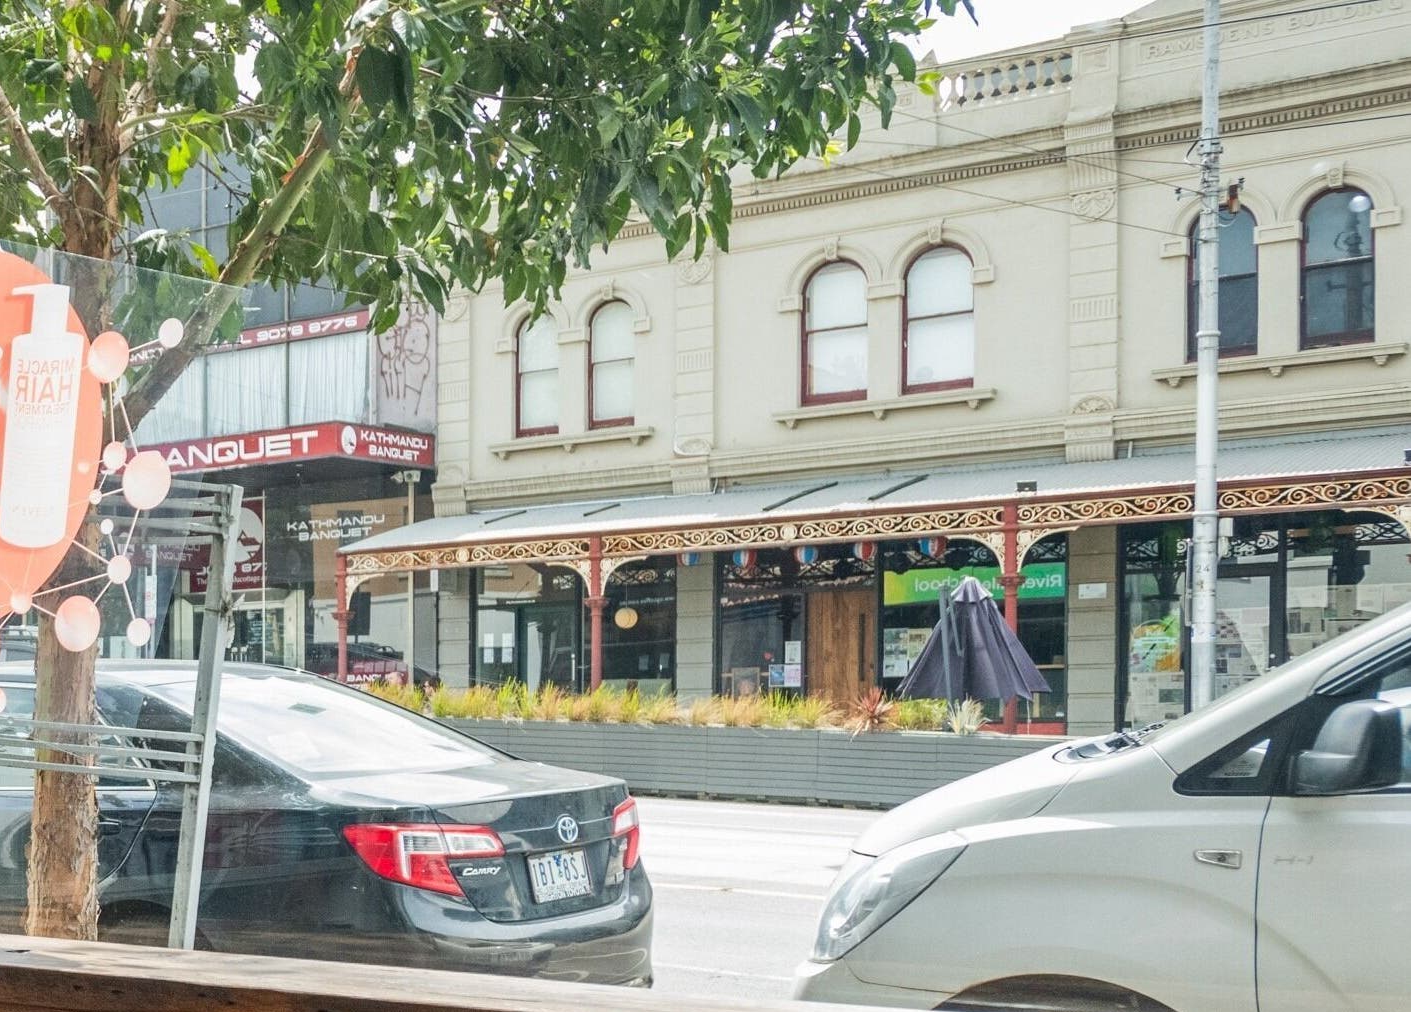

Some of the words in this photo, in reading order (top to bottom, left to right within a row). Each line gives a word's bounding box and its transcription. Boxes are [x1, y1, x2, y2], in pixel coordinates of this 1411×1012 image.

[360, 429, 428, 449] KATHMANDU
[164, 430, 318, 468] ANQUET
[368, 445, 420, 462] BANQUET
[286, 514, 386, 532] KATHMANDU
[298, 526, 372, 541] BANQUET
